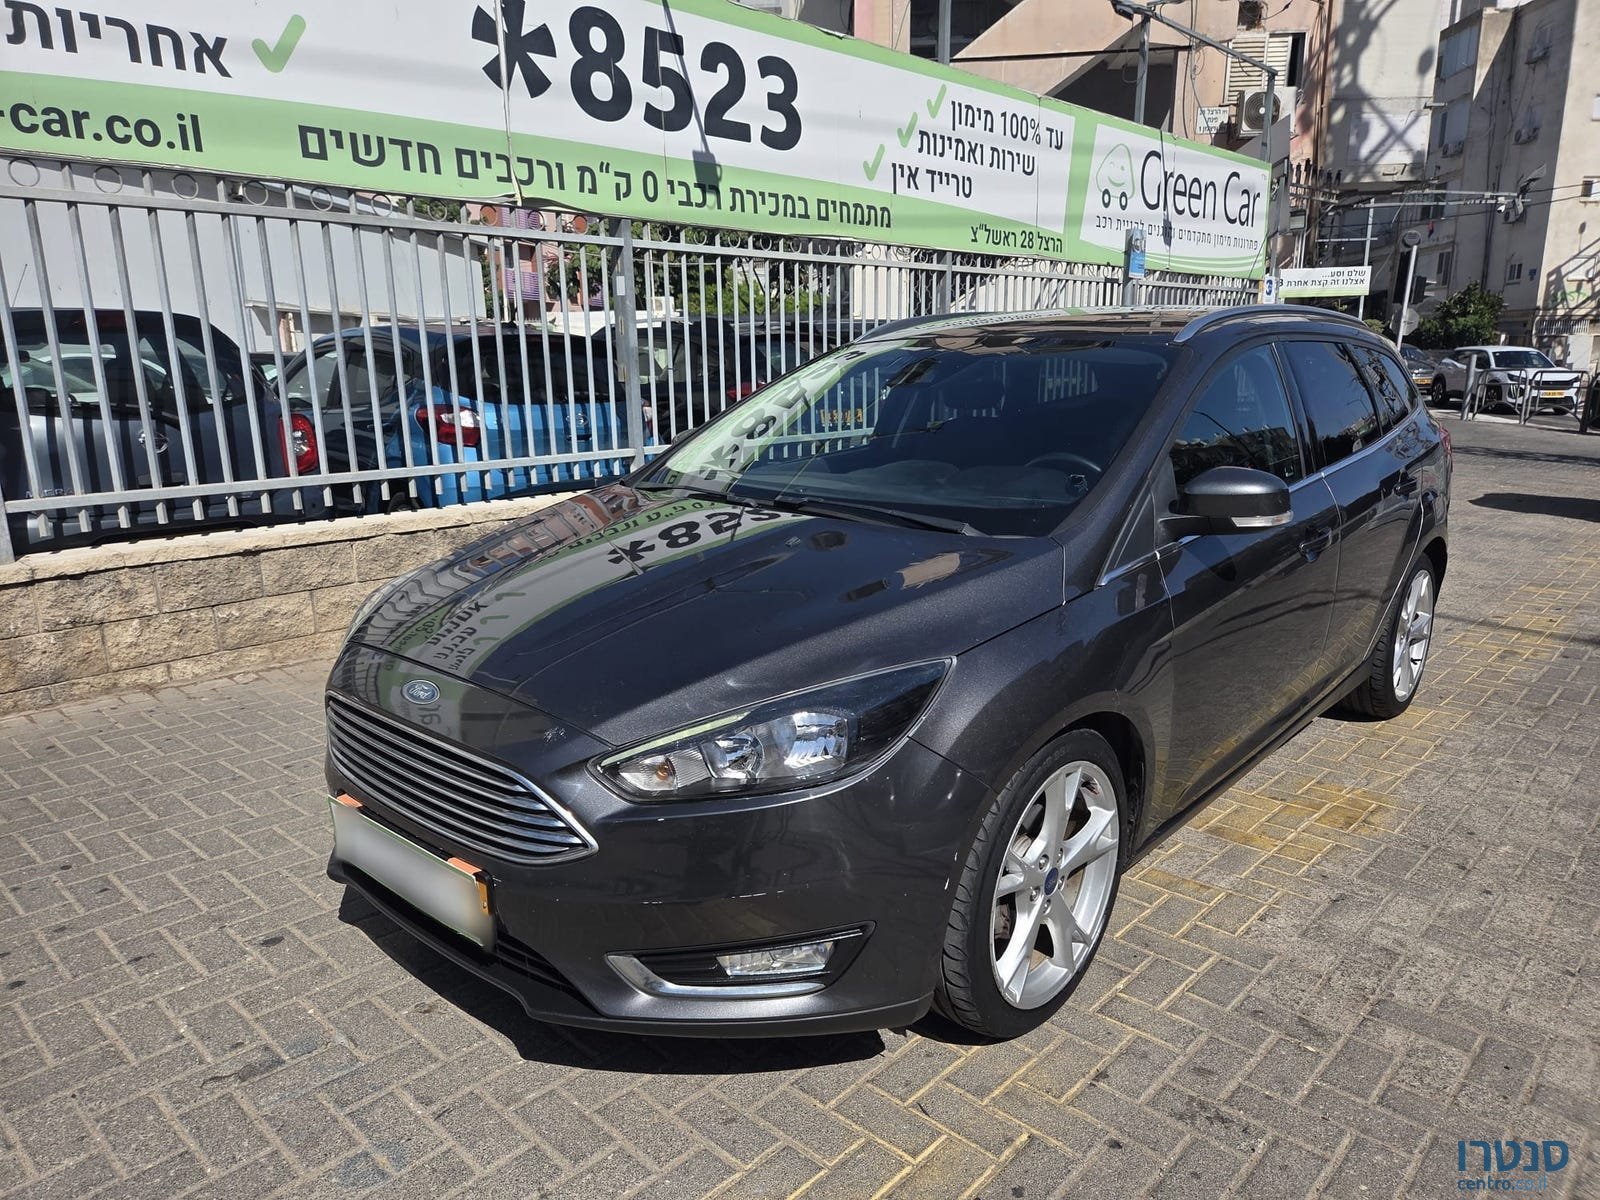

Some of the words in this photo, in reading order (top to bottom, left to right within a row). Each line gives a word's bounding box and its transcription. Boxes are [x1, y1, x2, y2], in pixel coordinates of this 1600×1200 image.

[5, 1, 232, 78] אחריות
[951, 100, 994, 132] מימון
[1000, 111, 1041, 145] 100%
[298, 125, 442, 175] חדשים
[918, 130, 984, 166] ואמינות
[1046, 126, 1063, 150] עד
[455, 147, 565, 191] ורכבים
[989, 146, 1035, 176] שירות
[643, 170, 658, 203] 0
[892, 162, 919, 194] אין
[926, 168, 972, 198] טרייד
[1141, 150, 1217, 220] Green
[1224, 171, 1260, 228] Car
[667, 179, 722, 210] רכבי
[730, 187, 810, 219] במכירת
[817, 198, 891, 228] מתמחים
[1096, 215, 1112, 229] רכב
[1020, 230, 1034, 249] 28
[1037, 231, 1063, 253] הרצל
[1178, 228, 1211, 245] מתקדמים
[1213, 233, 1231, 248] מימון
[1347, 269, 1366, 277] שלם
